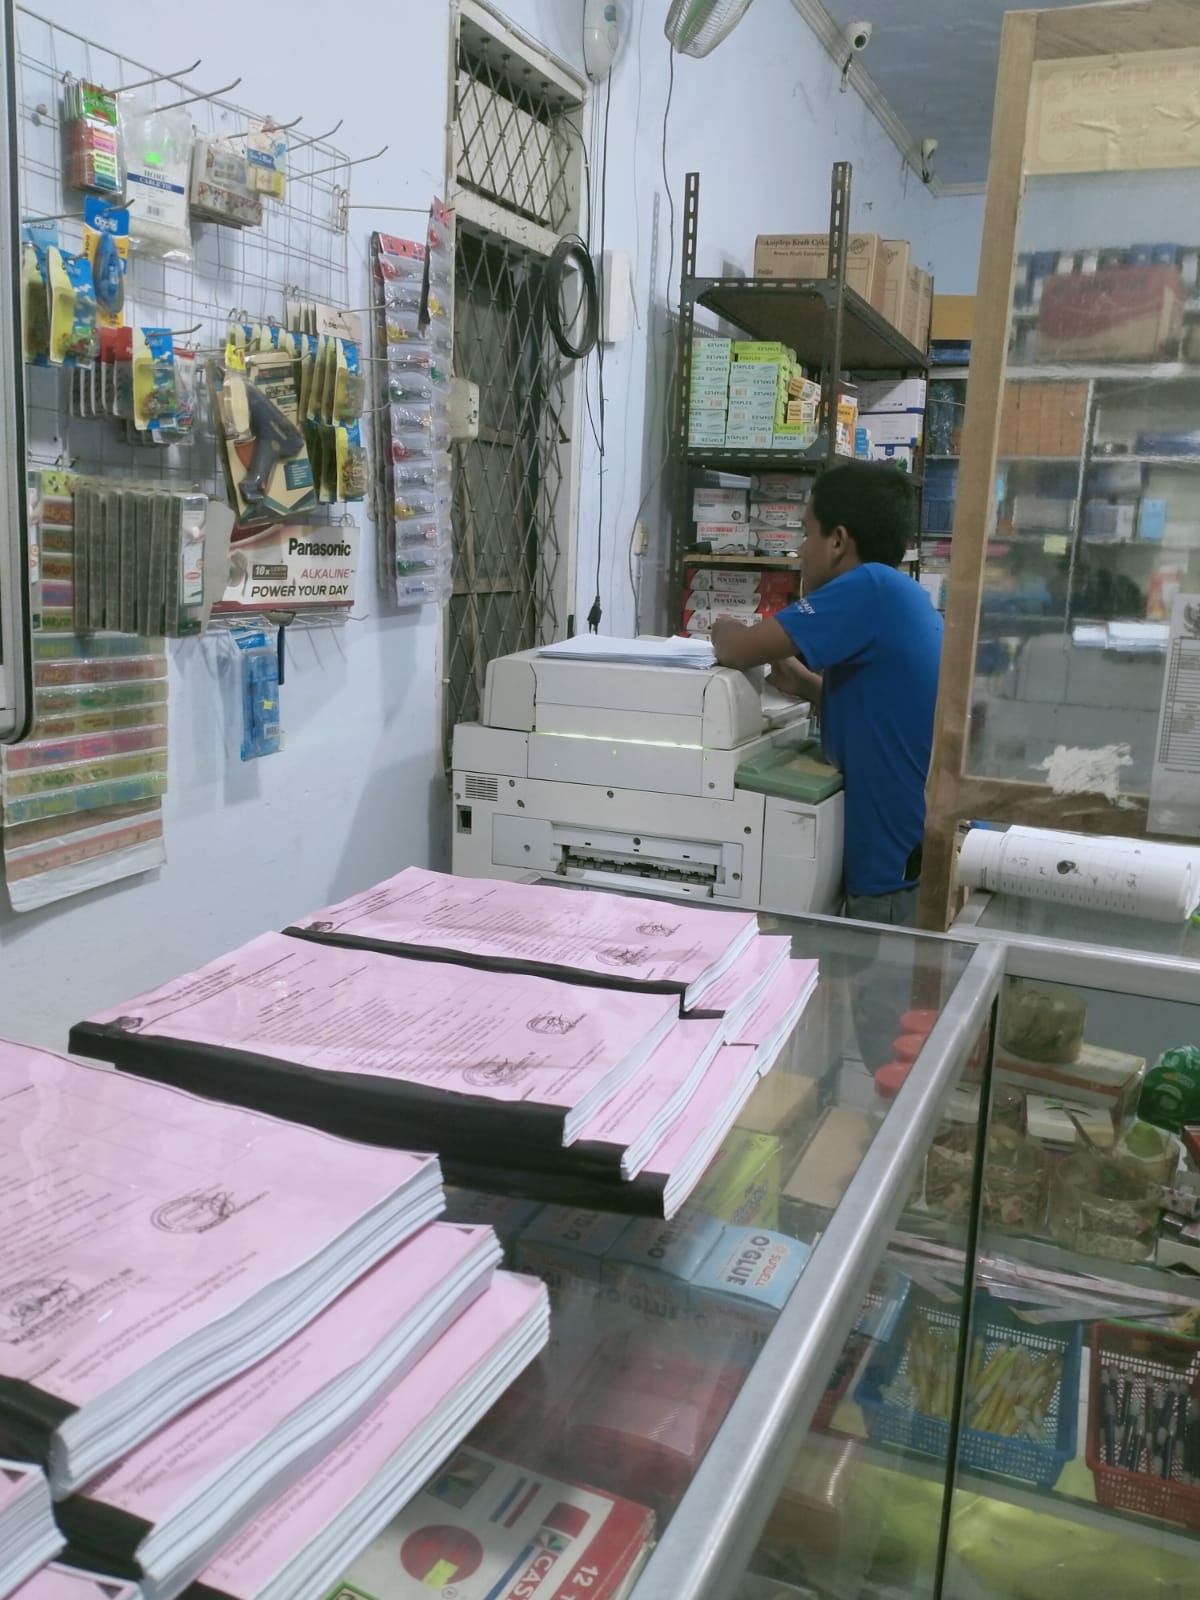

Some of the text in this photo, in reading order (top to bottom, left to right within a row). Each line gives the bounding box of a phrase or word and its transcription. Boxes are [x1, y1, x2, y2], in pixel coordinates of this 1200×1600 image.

[288, 537, 352, 556] Panasonic
[301, 568, 350, 579] ALKALINE
[251, 584, 349, 597] POWER YOUR DAY
[726, 1235, 770, 1286] O'GLUE
[507, 1555, 554, 1600] CAS
[572, 1566, 599, 1587] 12
